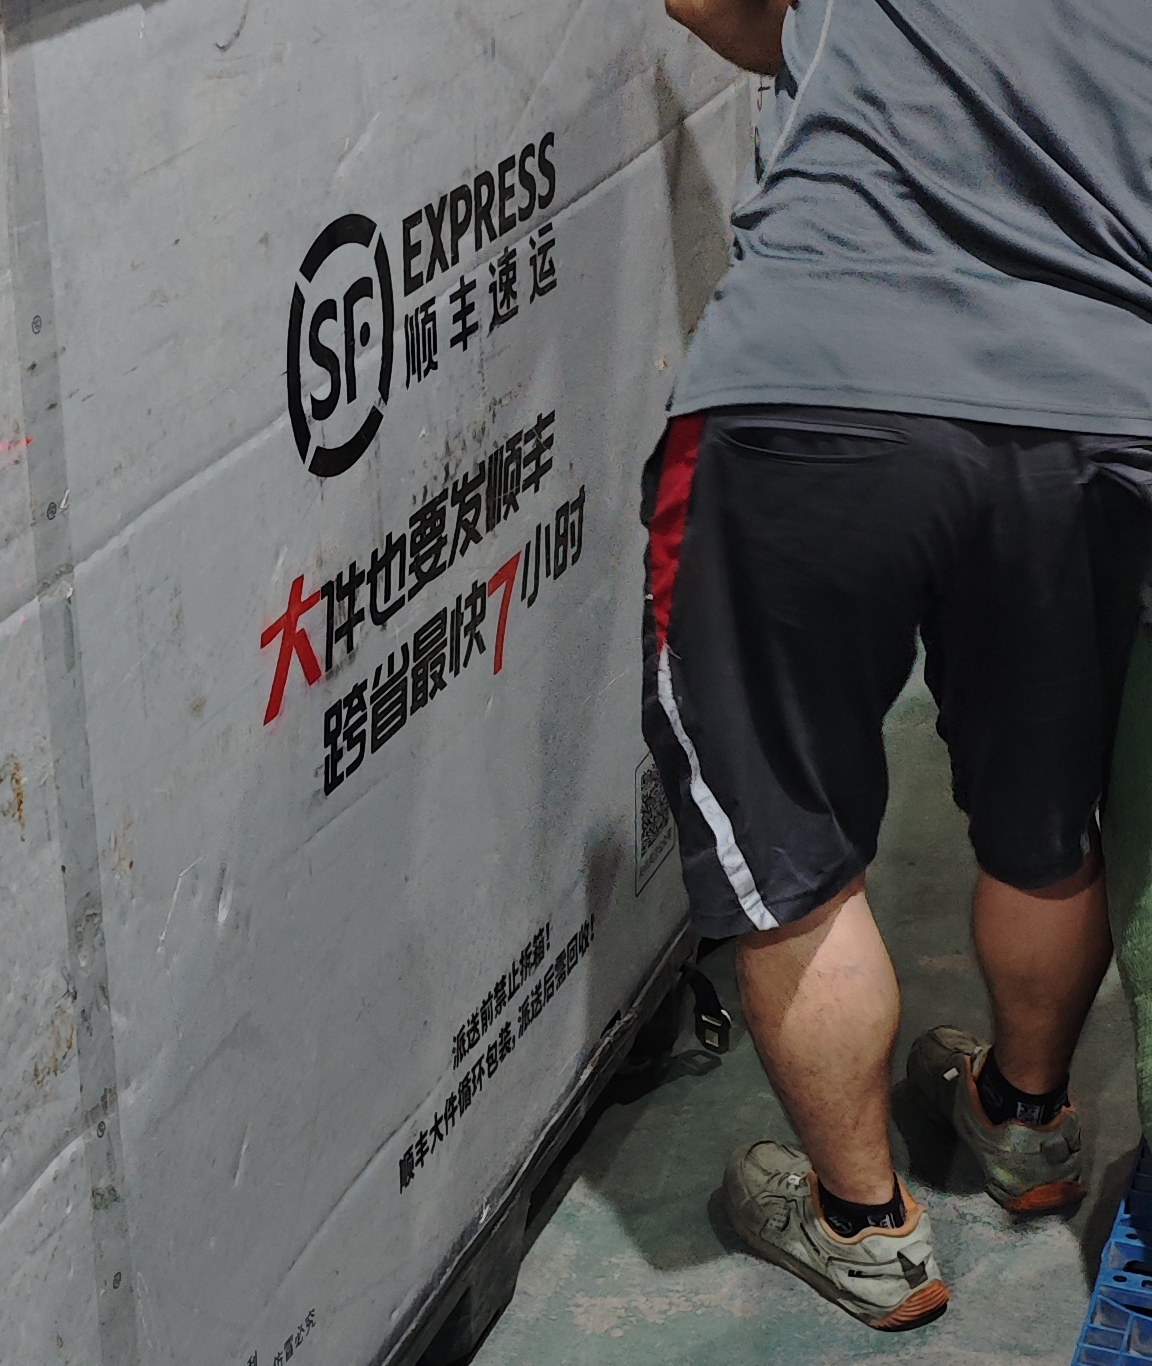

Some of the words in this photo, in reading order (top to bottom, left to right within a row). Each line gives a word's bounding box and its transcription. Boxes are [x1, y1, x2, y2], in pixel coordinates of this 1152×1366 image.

[402, 132, 556, 297] EXPRESS
[404, 222, 557, 390] 顺丰速运
[260, 410, 555, 726] 大件也要发顺丰
[324, 485, 586, 796] 跨省最快7小时
[452, 921, 552, 1071] 派送前禁止拆箱！
